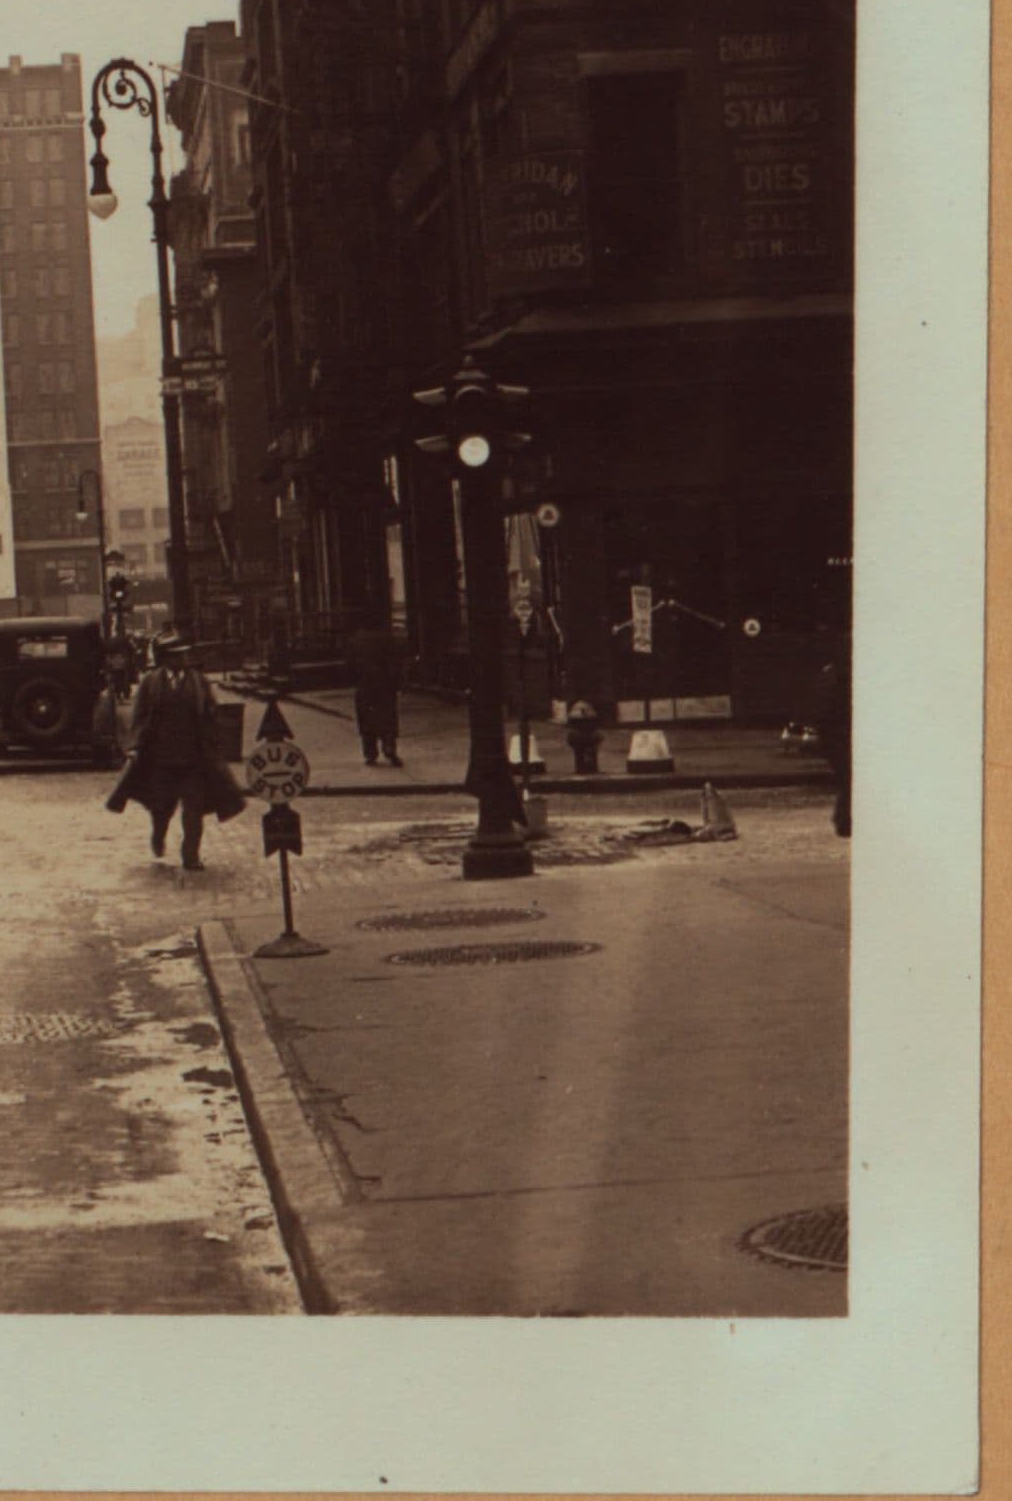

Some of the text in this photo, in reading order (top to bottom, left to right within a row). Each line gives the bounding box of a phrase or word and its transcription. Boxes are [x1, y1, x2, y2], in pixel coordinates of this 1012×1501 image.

[744, 164, 811, 192] DIES
[251, 747, 302, 771] BUS
[252, 773, 304, 798] STOP
